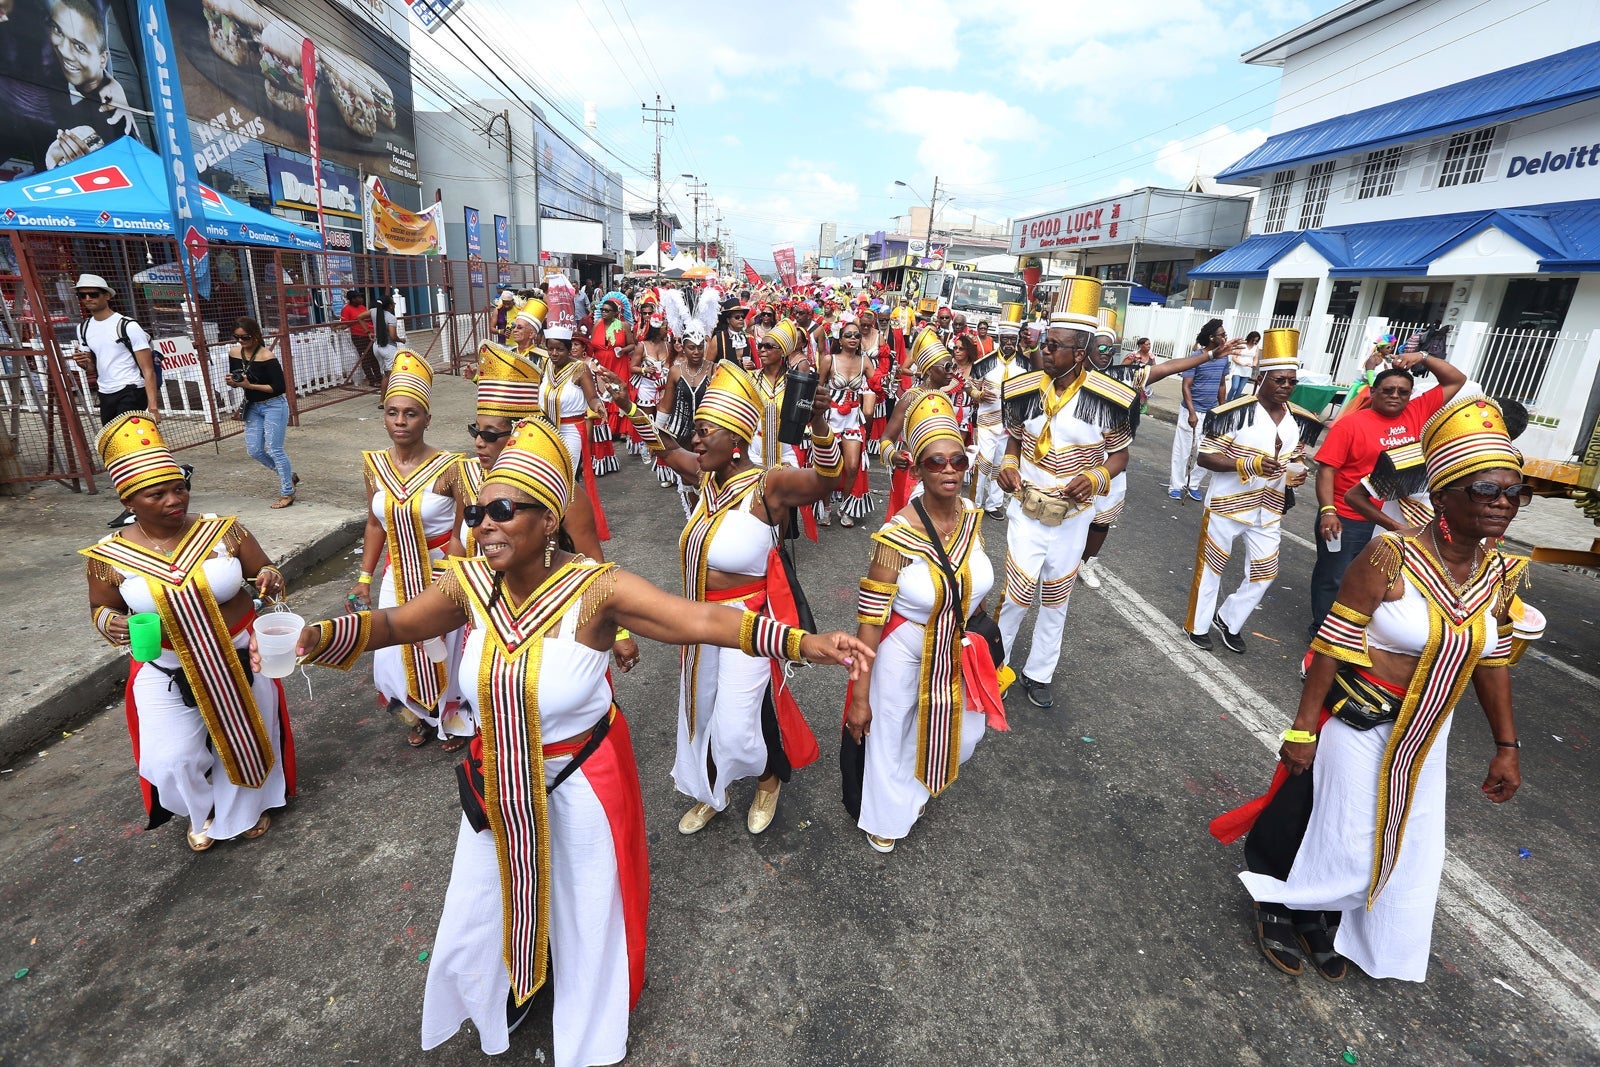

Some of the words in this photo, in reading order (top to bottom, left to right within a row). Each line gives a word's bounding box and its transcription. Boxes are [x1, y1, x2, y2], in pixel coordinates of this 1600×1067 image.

[196, 112, 231, 145] HOT
[229, 106, 244, 126] &
[193, 116, 265, 174] DELICIOUS
[1506, 143, 1600, 178] Deloitt
[280, 171, 357, 213] Domino's
[17, 214, 77, 227] Domino's
[113, 217, 171, 230] Domino's
[1030, 217, 1062, 239] GOOD
[1066, 208, 1104, 234] LUCK
[248, 230, 280, 243] Domino's
[295, 237, 322, 250] Domino's
[325, 230, 352, 248] -0555
[159, 340, 177, 354] NO
[161, 352, 198, 370] ARKING
